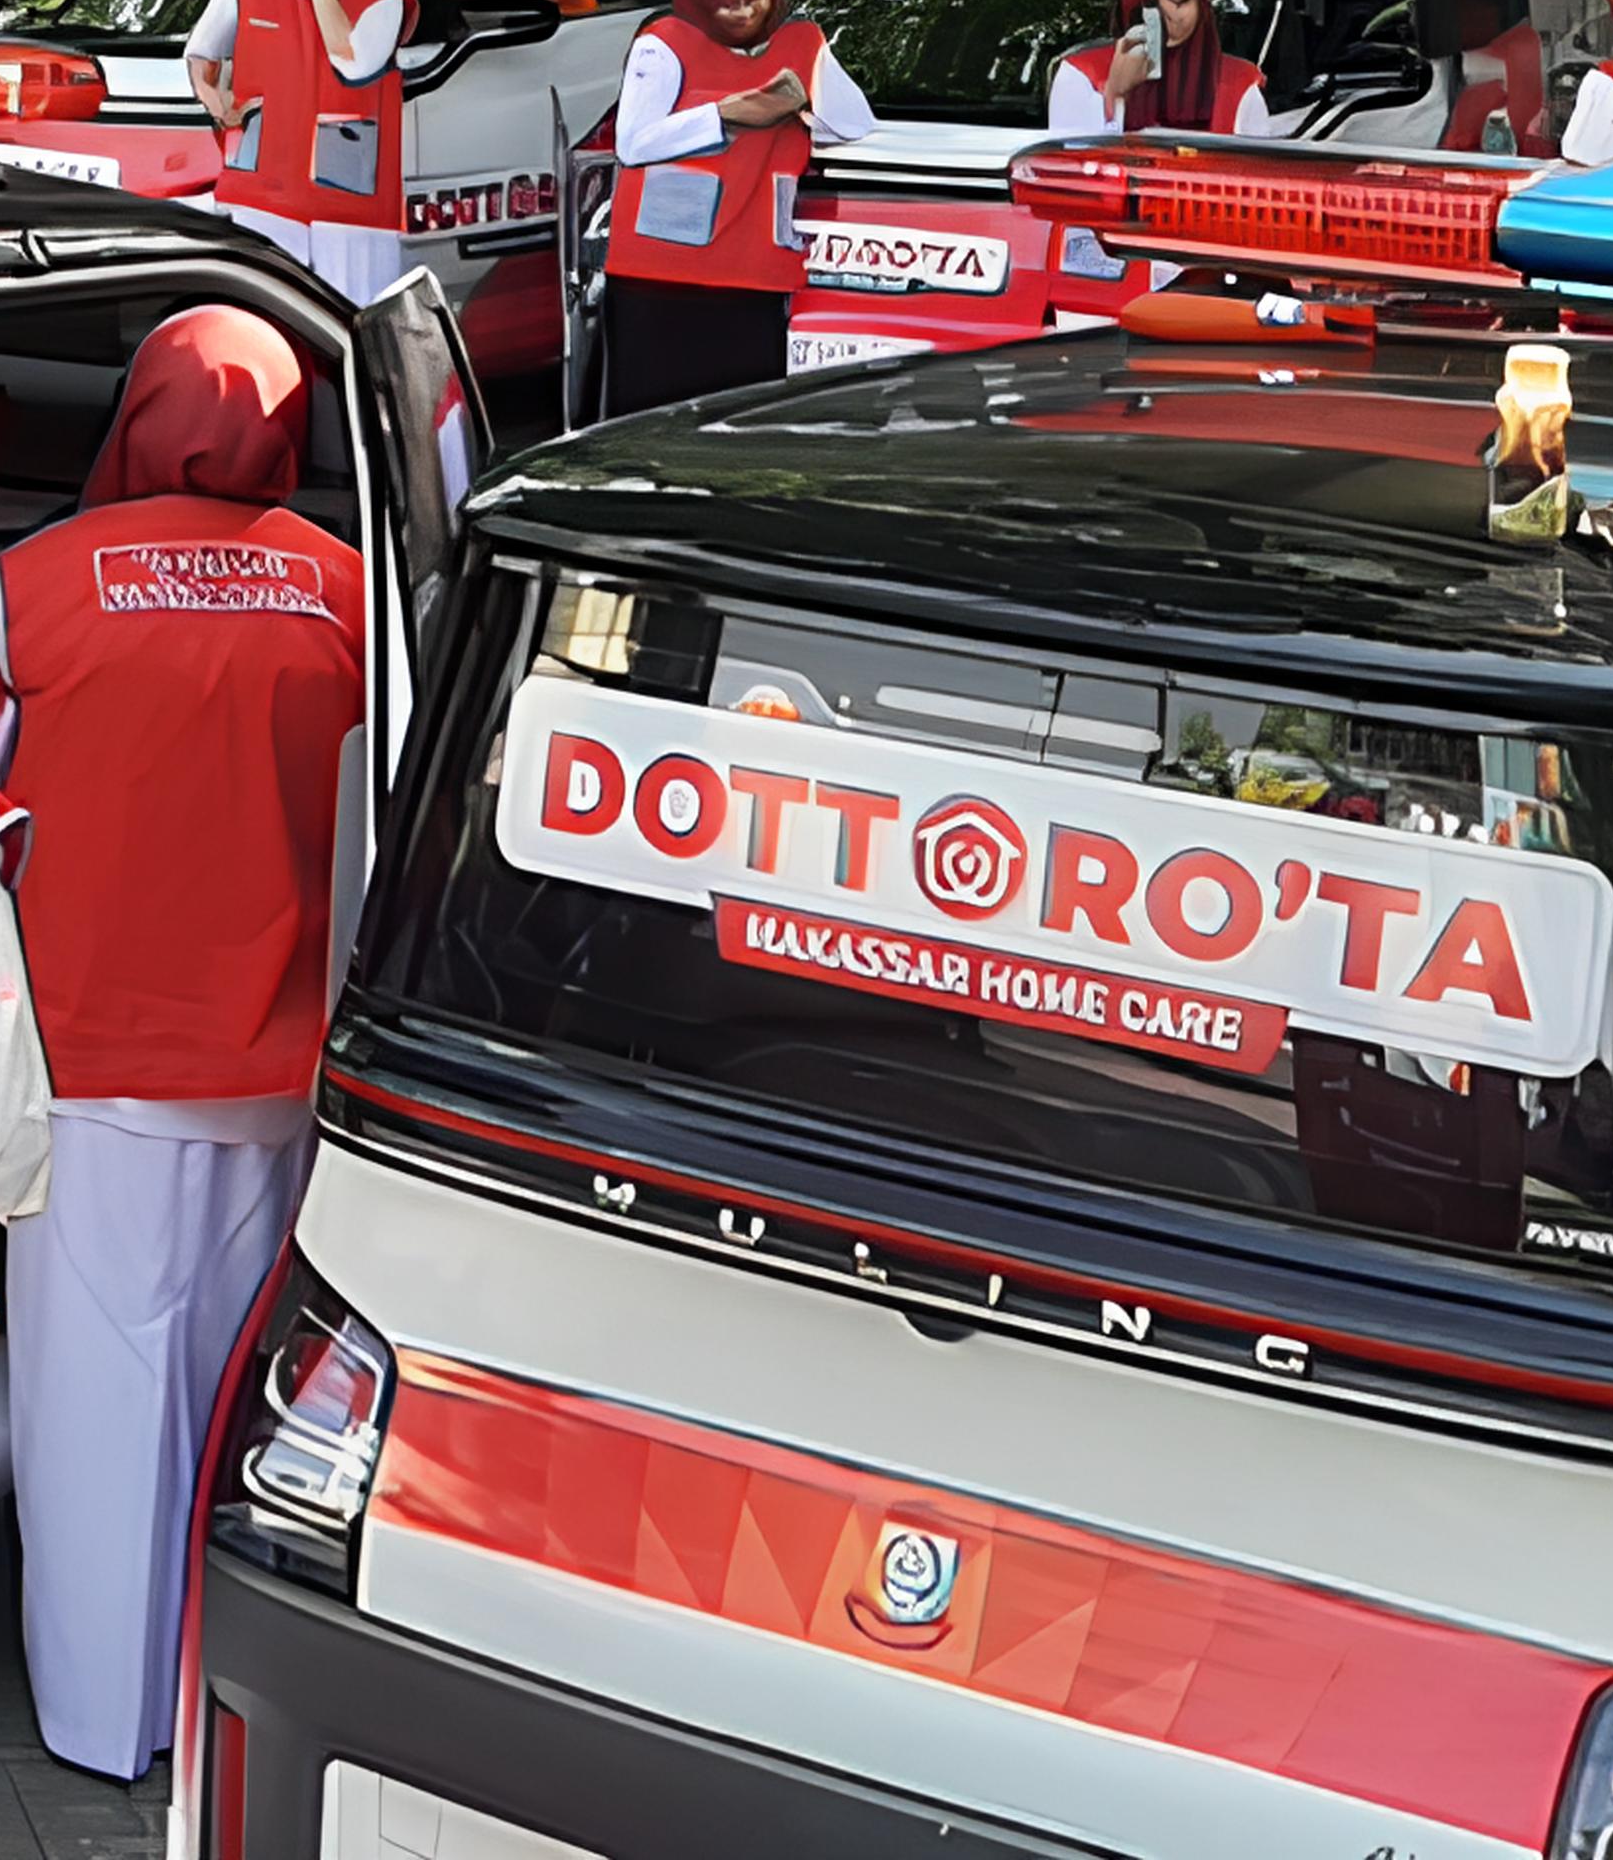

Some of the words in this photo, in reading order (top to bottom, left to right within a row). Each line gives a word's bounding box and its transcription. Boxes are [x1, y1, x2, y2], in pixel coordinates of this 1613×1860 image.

[746, 912, 970, 998] MAKASSAR
[980, 960, 1108, 1026] HOME
[1120, 988, 1243, 1052] CARE
